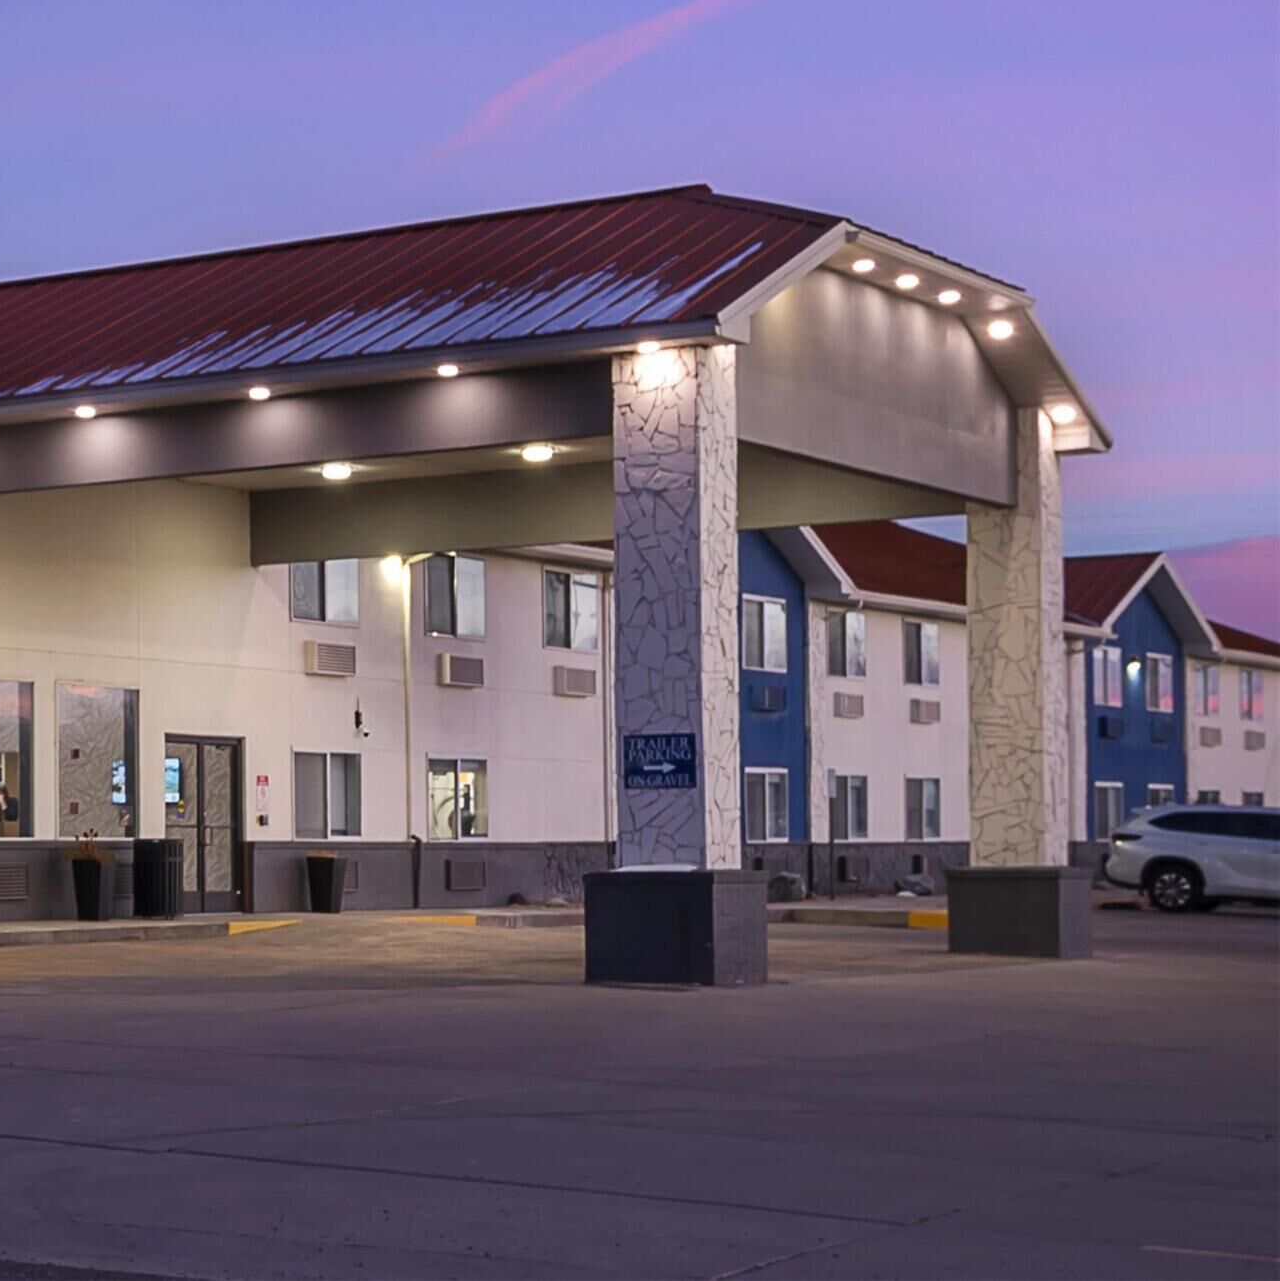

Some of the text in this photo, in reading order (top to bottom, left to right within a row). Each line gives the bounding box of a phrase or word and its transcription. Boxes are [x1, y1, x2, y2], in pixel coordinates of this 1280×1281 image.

[630, 737, 688, 750] TRAILER
[629, 748, 691, 761] PARKING
[628, 774, 689, 787] ON GRAVEL
